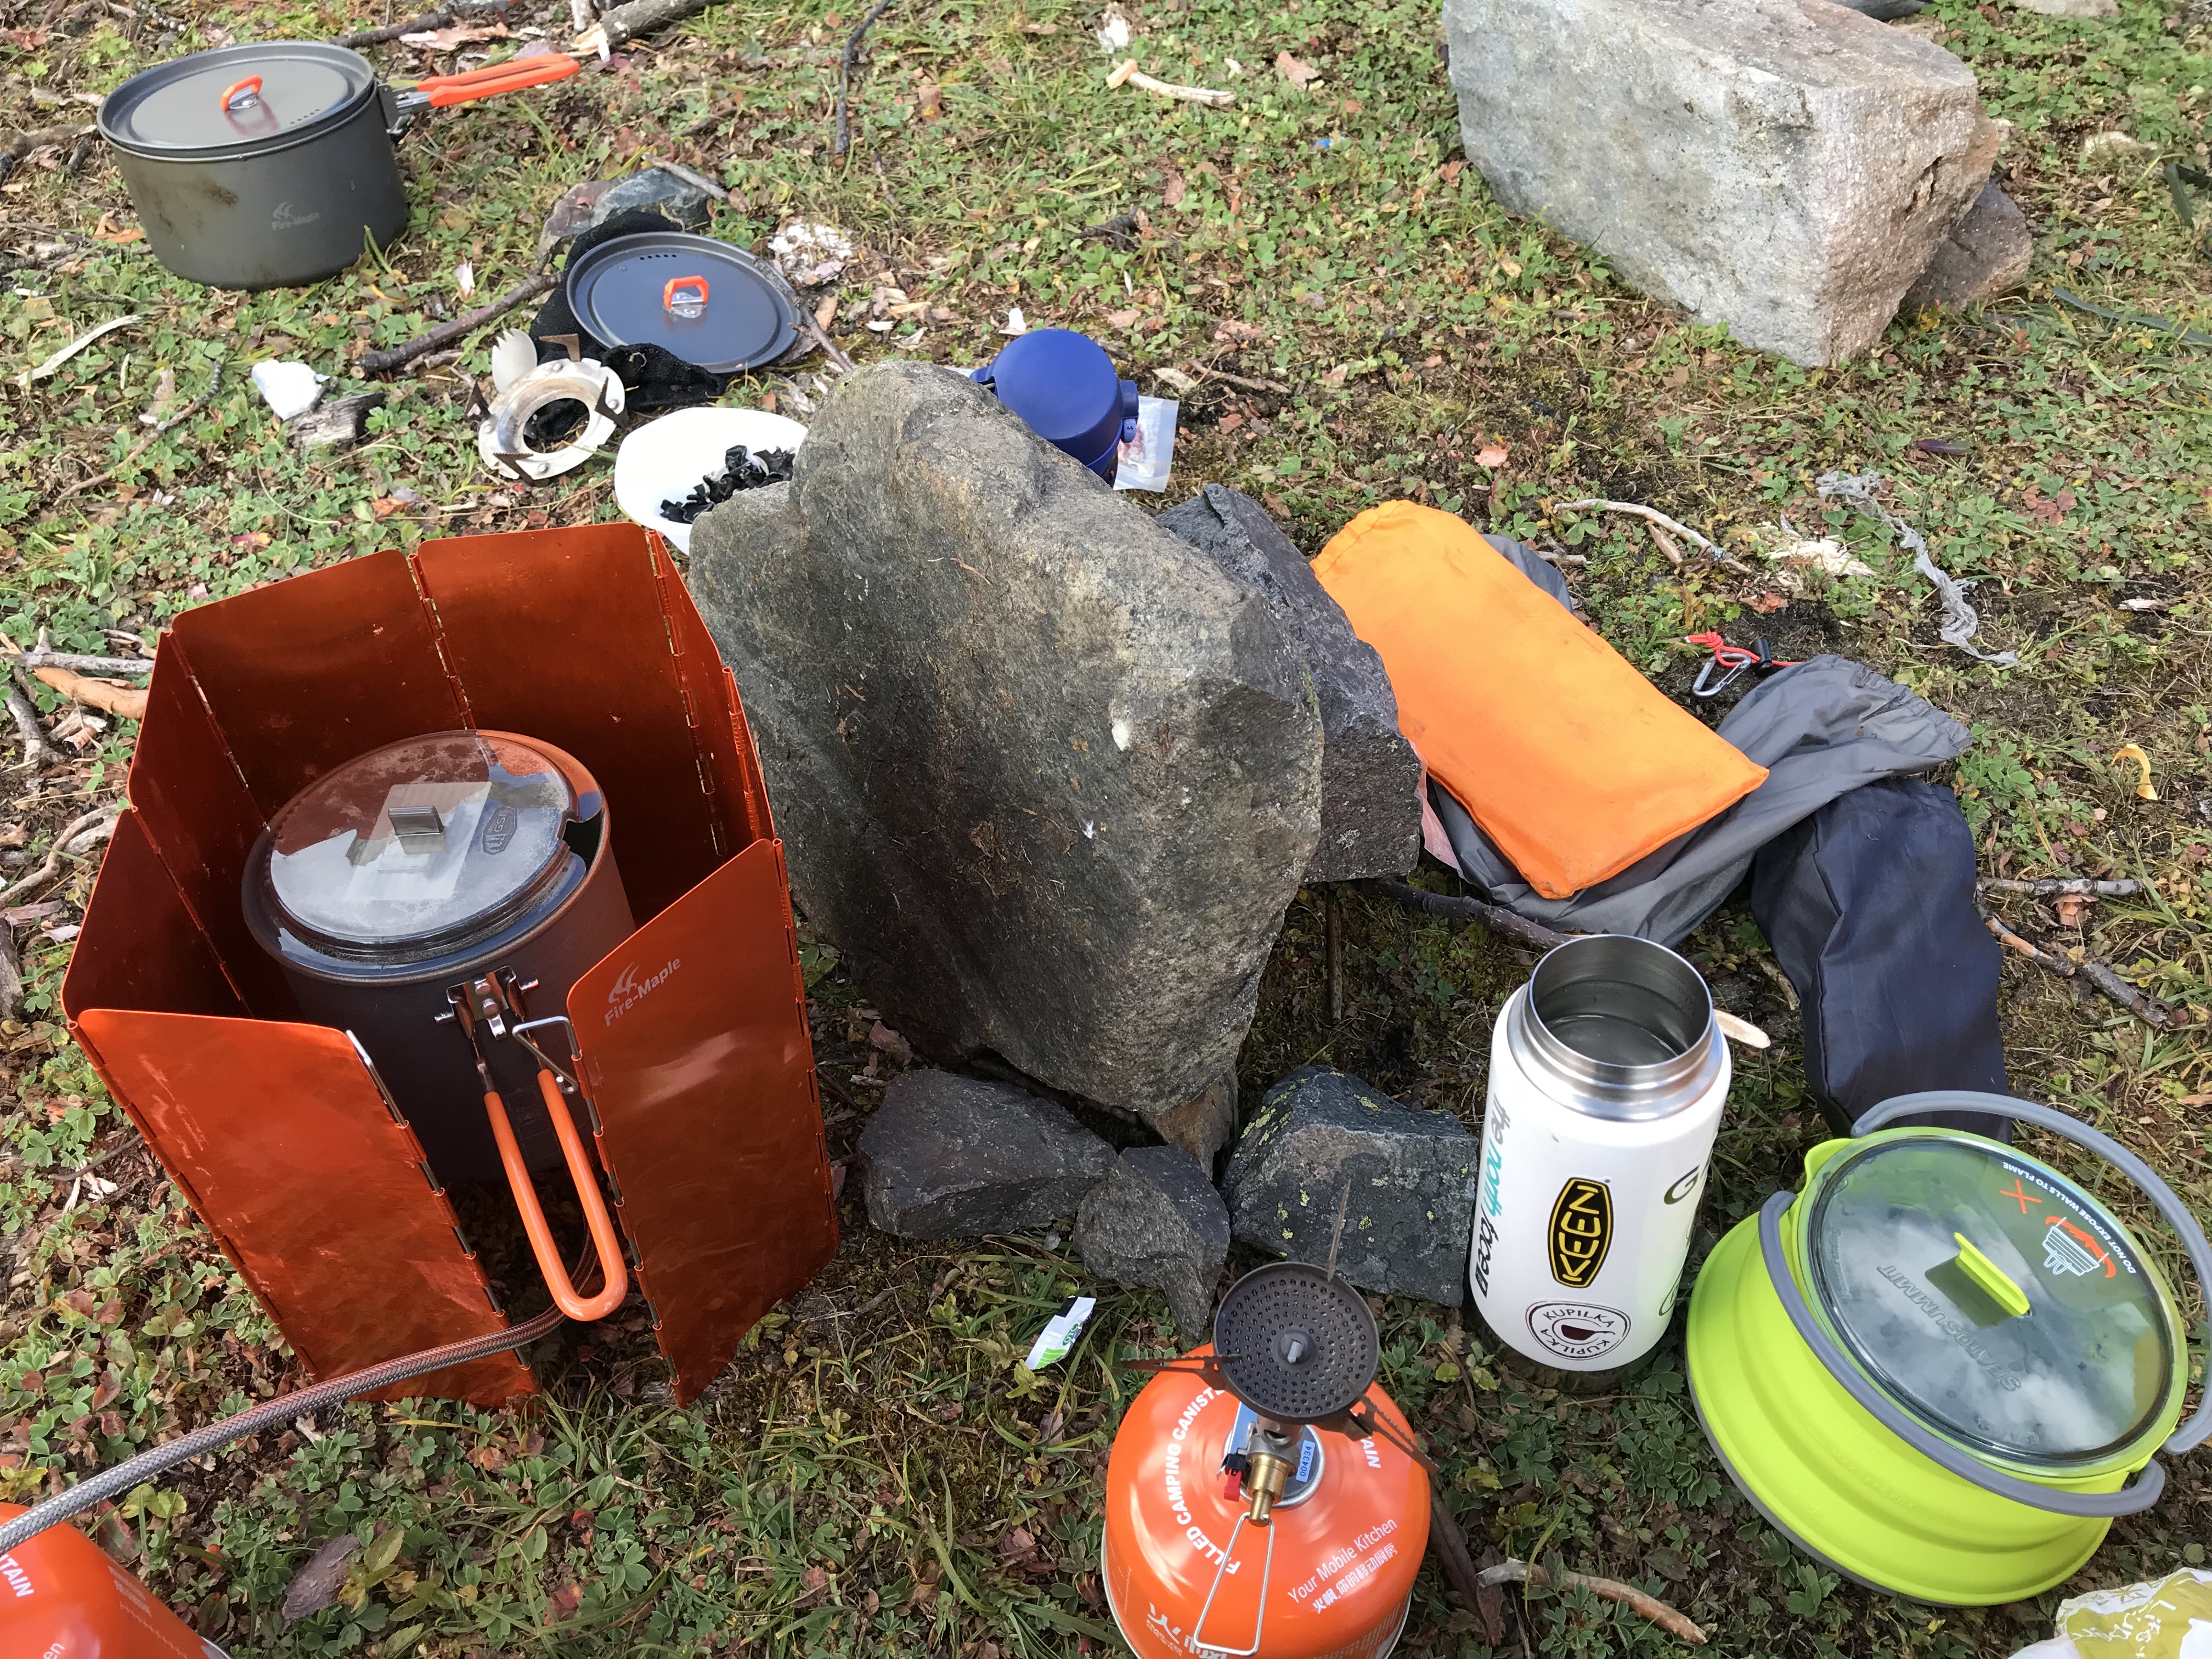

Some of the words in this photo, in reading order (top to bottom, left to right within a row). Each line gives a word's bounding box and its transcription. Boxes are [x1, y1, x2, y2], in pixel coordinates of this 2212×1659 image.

[494, 814, 507, 832] GSI
[605, 958, 681, 1026] Fire-Maple
[2002, 1161, 2035, 1182] FLAME
[2035, 1178, 2049, 1190] TO
[2049, 1186, 2080, 1212] WALLS
[1558, 1184, 1601, 1282] KEEN
[2078, 1209, 2112, 1240] EXPOSE
[2108, 1240, 2127, 1259] NOT
[2123, 1260, 2137, 1274] DO
[1542, 1308, 1615, 1328] KUPILKA
[1540, 1328, 1611, 1355] KUPILKA
[1172, 1386, 1225, 1441] CANIST
[1299, 1445, 1312, 1477] 004334
[1165, 1443, 1192, 1525] CAMPING
[1186, 1526, 1242, 1575] FLLED
[1287, 1576, 1318, 1604] Your
[1316, 1548, 1357, 1582] Mobile
[1353, 1519, 1398, 1553] Kitchen
